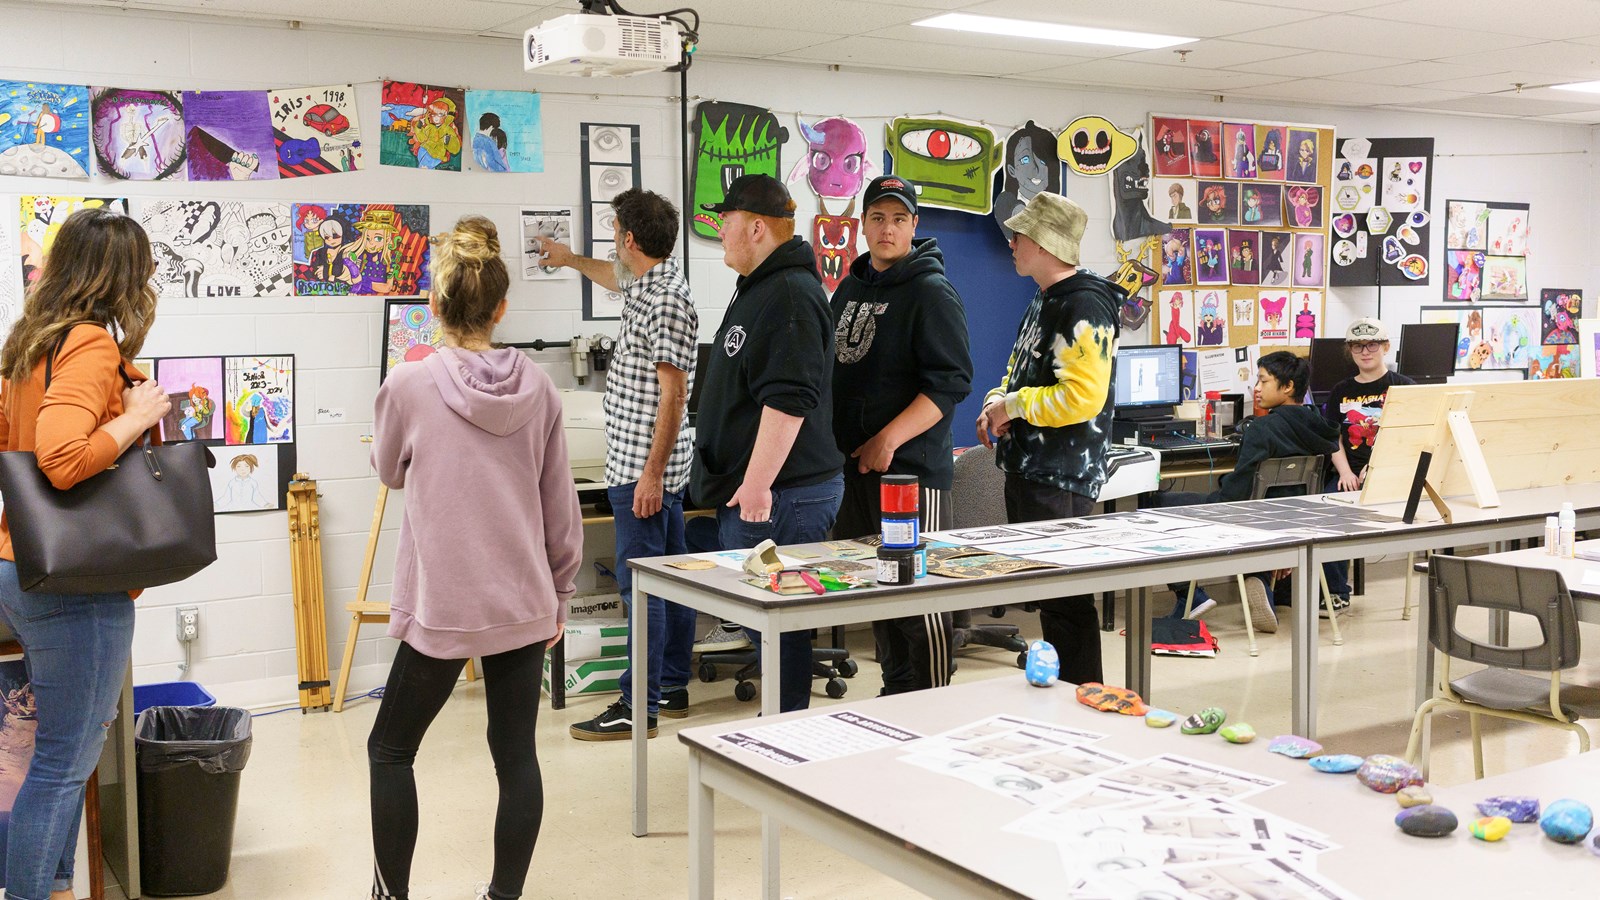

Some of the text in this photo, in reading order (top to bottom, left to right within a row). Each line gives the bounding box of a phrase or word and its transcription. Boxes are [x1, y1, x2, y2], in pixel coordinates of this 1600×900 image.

[323, 90, 345, 102] 1998
[254, 230, 287, 248] COOL
[207, 286, 241, 297] LOVE
[728, 333, 740, 349] A
[571, 601, 618, 614] ImageTONE
